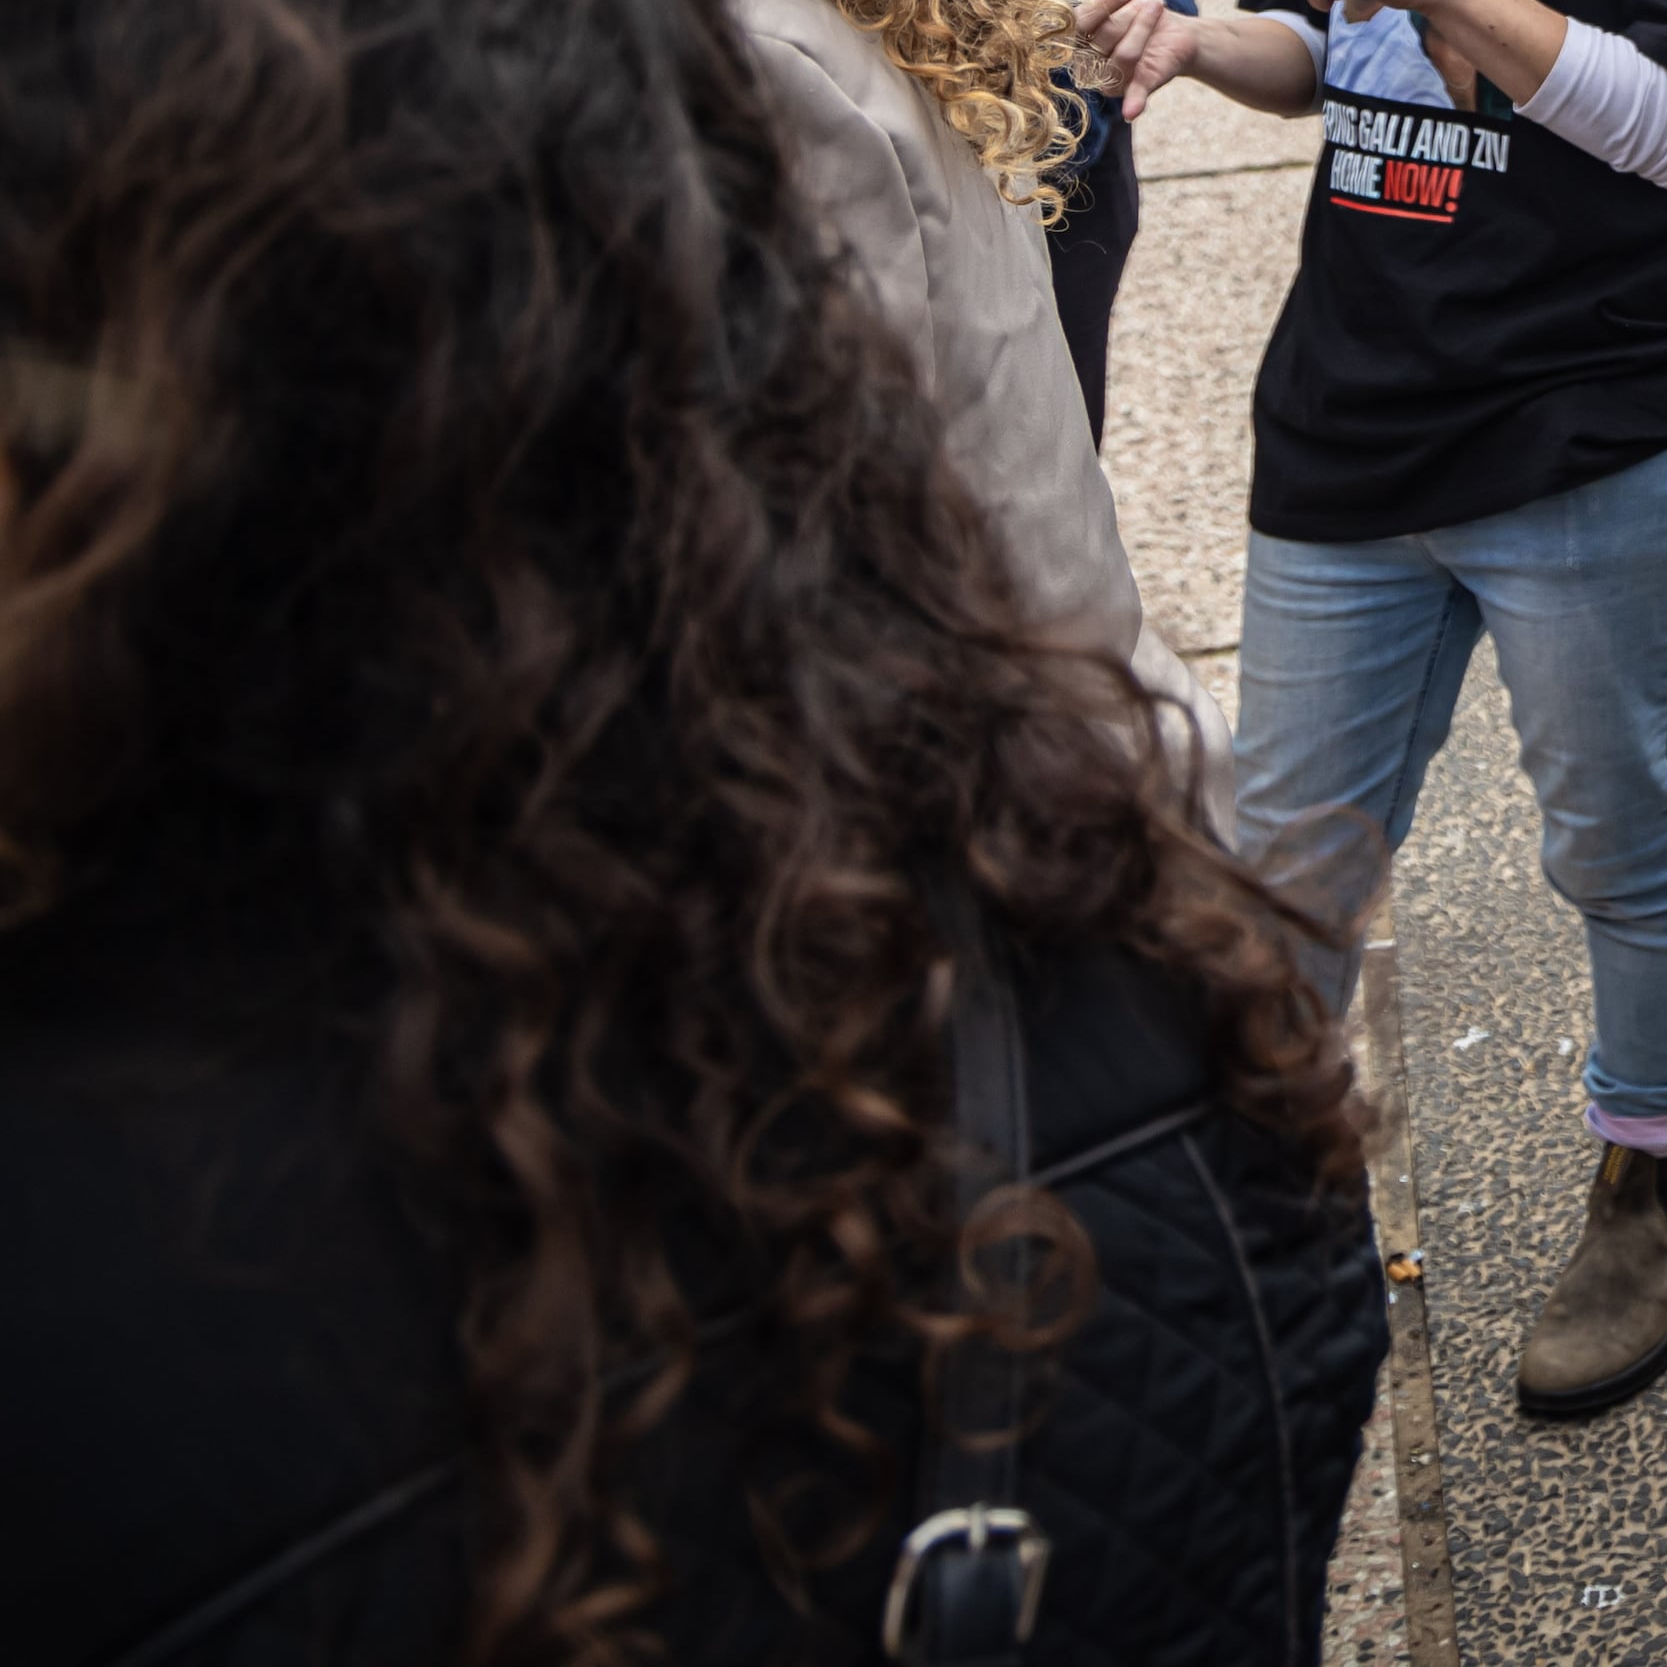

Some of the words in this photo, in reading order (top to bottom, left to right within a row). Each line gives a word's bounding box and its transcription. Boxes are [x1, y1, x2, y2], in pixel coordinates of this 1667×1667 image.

[1359, 109, 1414, 157] GALI
[1410, 118, 1470, 165] AND
[1471, 128, 1511, 173] ZIV
[1330, 149, 1384, 199] HOME
[1384, 160, 1464, 213] NOW!
